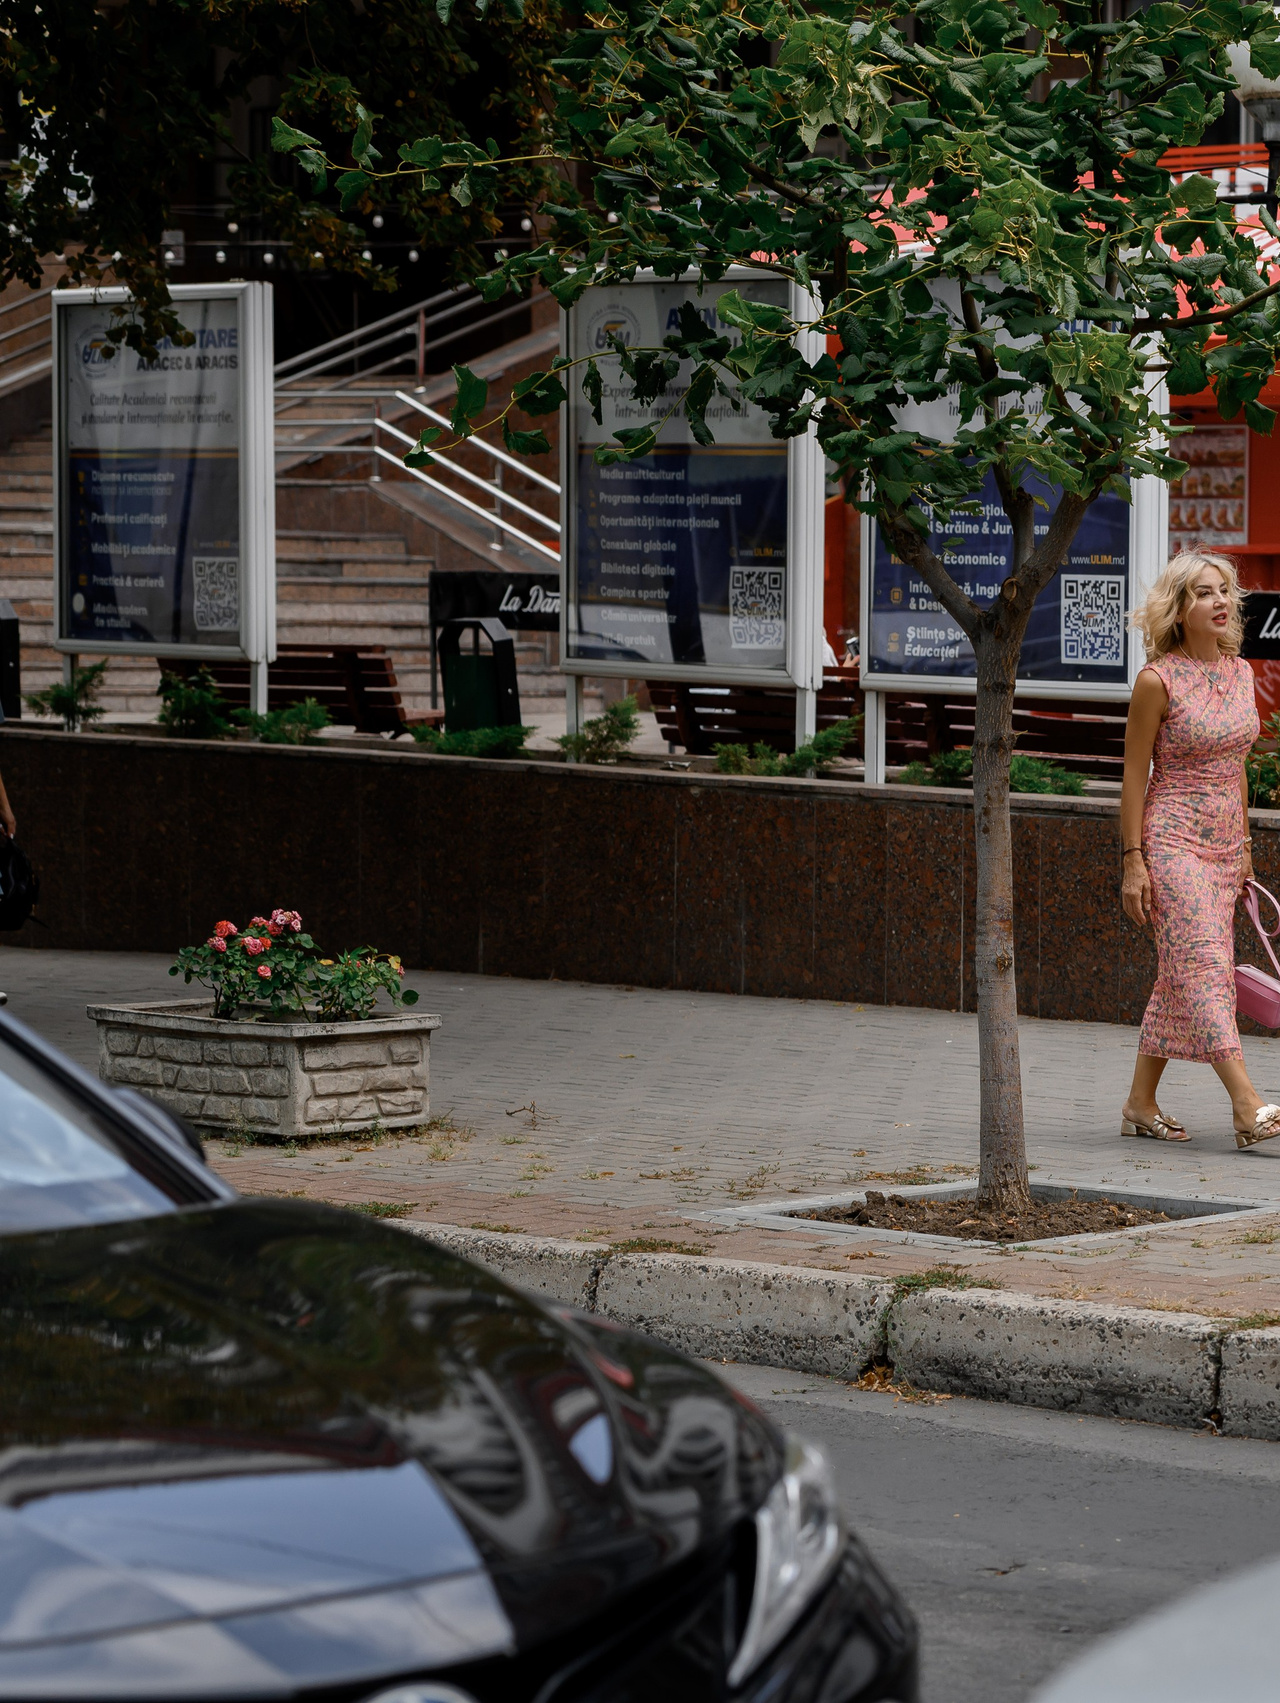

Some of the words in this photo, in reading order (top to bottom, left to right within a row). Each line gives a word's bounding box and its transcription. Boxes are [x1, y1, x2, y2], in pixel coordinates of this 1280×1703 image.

[600, 469, 623, 479] Mediu
[625, 469, 684, 479] multicultural
[600, 492, 640, 506] Programe
[643, 493, 684, 505] adaptate
[711, 495, 741, 505] muncii
[600, 515, 654, 530] Oportunități
[656, 517, 719, 531] internaționale
[936, 521, 978, 534] Străine
[981, 521, 990, 534] &
[601, 539, 641, 550] Conexiuni
[644, 540, 676, 553] globale
[1071, 555, 1125, 565] www.ULIM.md
[601, 562, 639, 574] Biblioteci
[642, 564, 675, 577] digitale
[499, 584, 522, 612] La
[601, 586, 635, 599] Complex
[638, 588, 669, 600] sportiv
[909, 598, 917, 610] &
[906, 626, 945, 644] Științe
[904, 644, 959, 662] Educației
